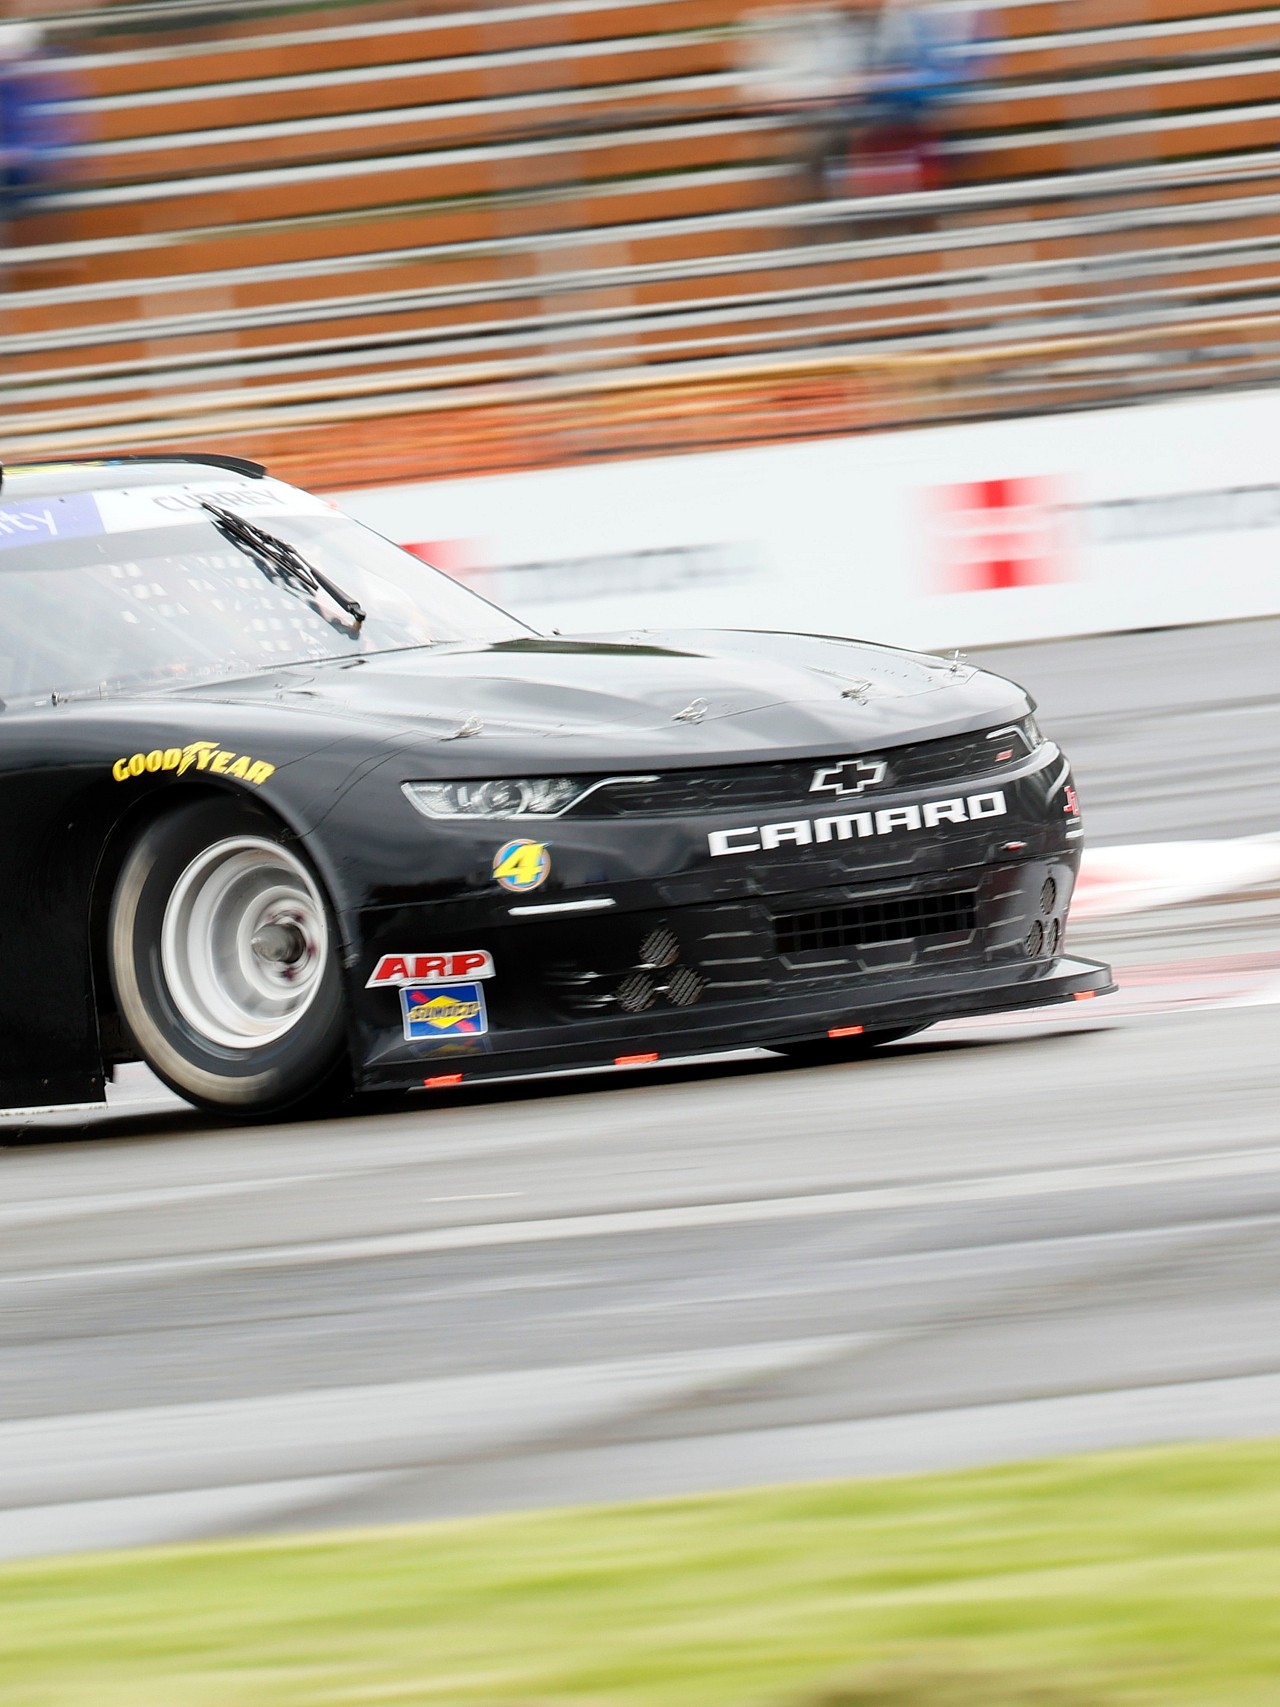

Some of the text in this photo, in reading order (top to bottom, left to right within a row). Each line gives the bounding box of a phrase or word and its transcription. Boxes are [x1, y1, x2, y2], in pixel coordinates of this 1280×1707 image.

[112, 741, 276, 785] GOODYEAR
[708, 790, 1007, 857] CAMARO
[492, 843, 548, 885] 4
[375, 953, 486, 980] ARP
